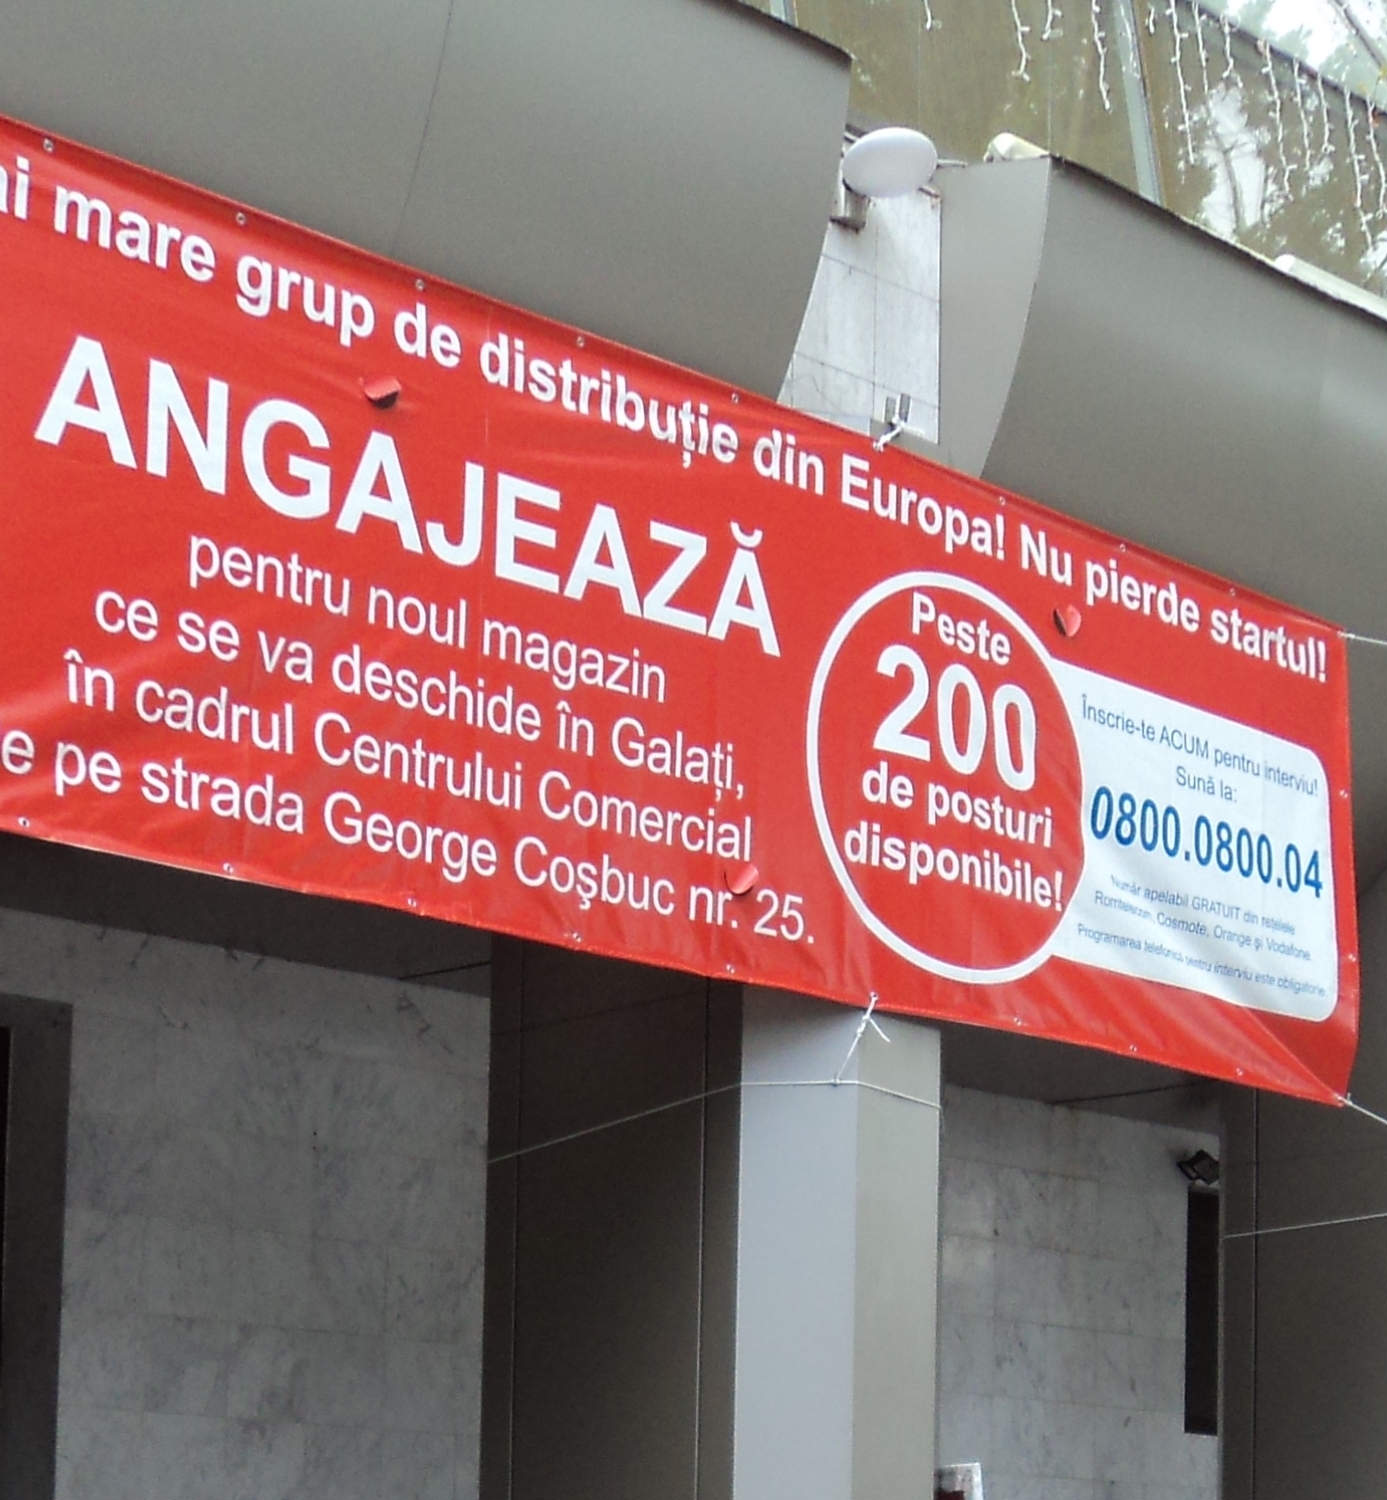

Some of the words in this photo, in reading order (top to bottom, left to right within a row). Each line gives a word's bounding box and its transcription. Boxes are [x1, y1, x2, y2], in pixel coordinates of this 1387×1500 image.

[53, 184, 216, 282] mare
[236, 254, 375, 348] grup
[393, 302, 462, 368] de
[752, 428, 824, 496] din
[841, 453, 1006, 561] Europa!
[1019, 523, 1073, 587] Nu
[1085, 558, 1200, 633] pierde
[1209, 610, 1326, 683] startul!
[33, 335, 782, 658] ANGAJEAZĂ
[95, 590, 159, 642] ce
[177, 611, 240, 662] se
[257, 630, 314, 684] va
[331, 644, 542, 743] deschide
[555, 700, 595, 757] în
[189, 535, 351, 617] pentru
[367, 586, 467, 649] noul
[482, 620, 667, 704] magazin
[911, 591, 1011, 666] Peste
[63, 648, 115, 712] în
[135, 679, 294, 755] cadrul
[312, 711, 522, 812] Centrului
[538, 769, 752, 862] Comercial
[872, 644, 1036, 791] 200
[1082, 694, 1156, 741] Înscrie-te
[1160, 725, 1209, 759] ACUM
[1214, 748, 1260, 777] pentru
[1264, 760, 1318, 797] interviu!
[861, 760, 914, 809] de
[927, 782, 1052, 849] posturi
[1176, 766, 1216, 796] Sună
[1220, 779, 1238, 803] la:
[54, 742, 122, 797] pe
[141, 757, 304, 835] strada
[324, 791, 498, 884] George
[688, 885, 738, 929] nr.
[753, 888, 815, 944] 25.
[843, 822, 1063, 913] disponibile!
[1090, 786, 1323, 898] 0800.0800.04
[1143, 888, 1189, 907] apelabil
[1191, 896, 1241, 920] GRATUIT
[1213, 925, 1251, 948] Orange
